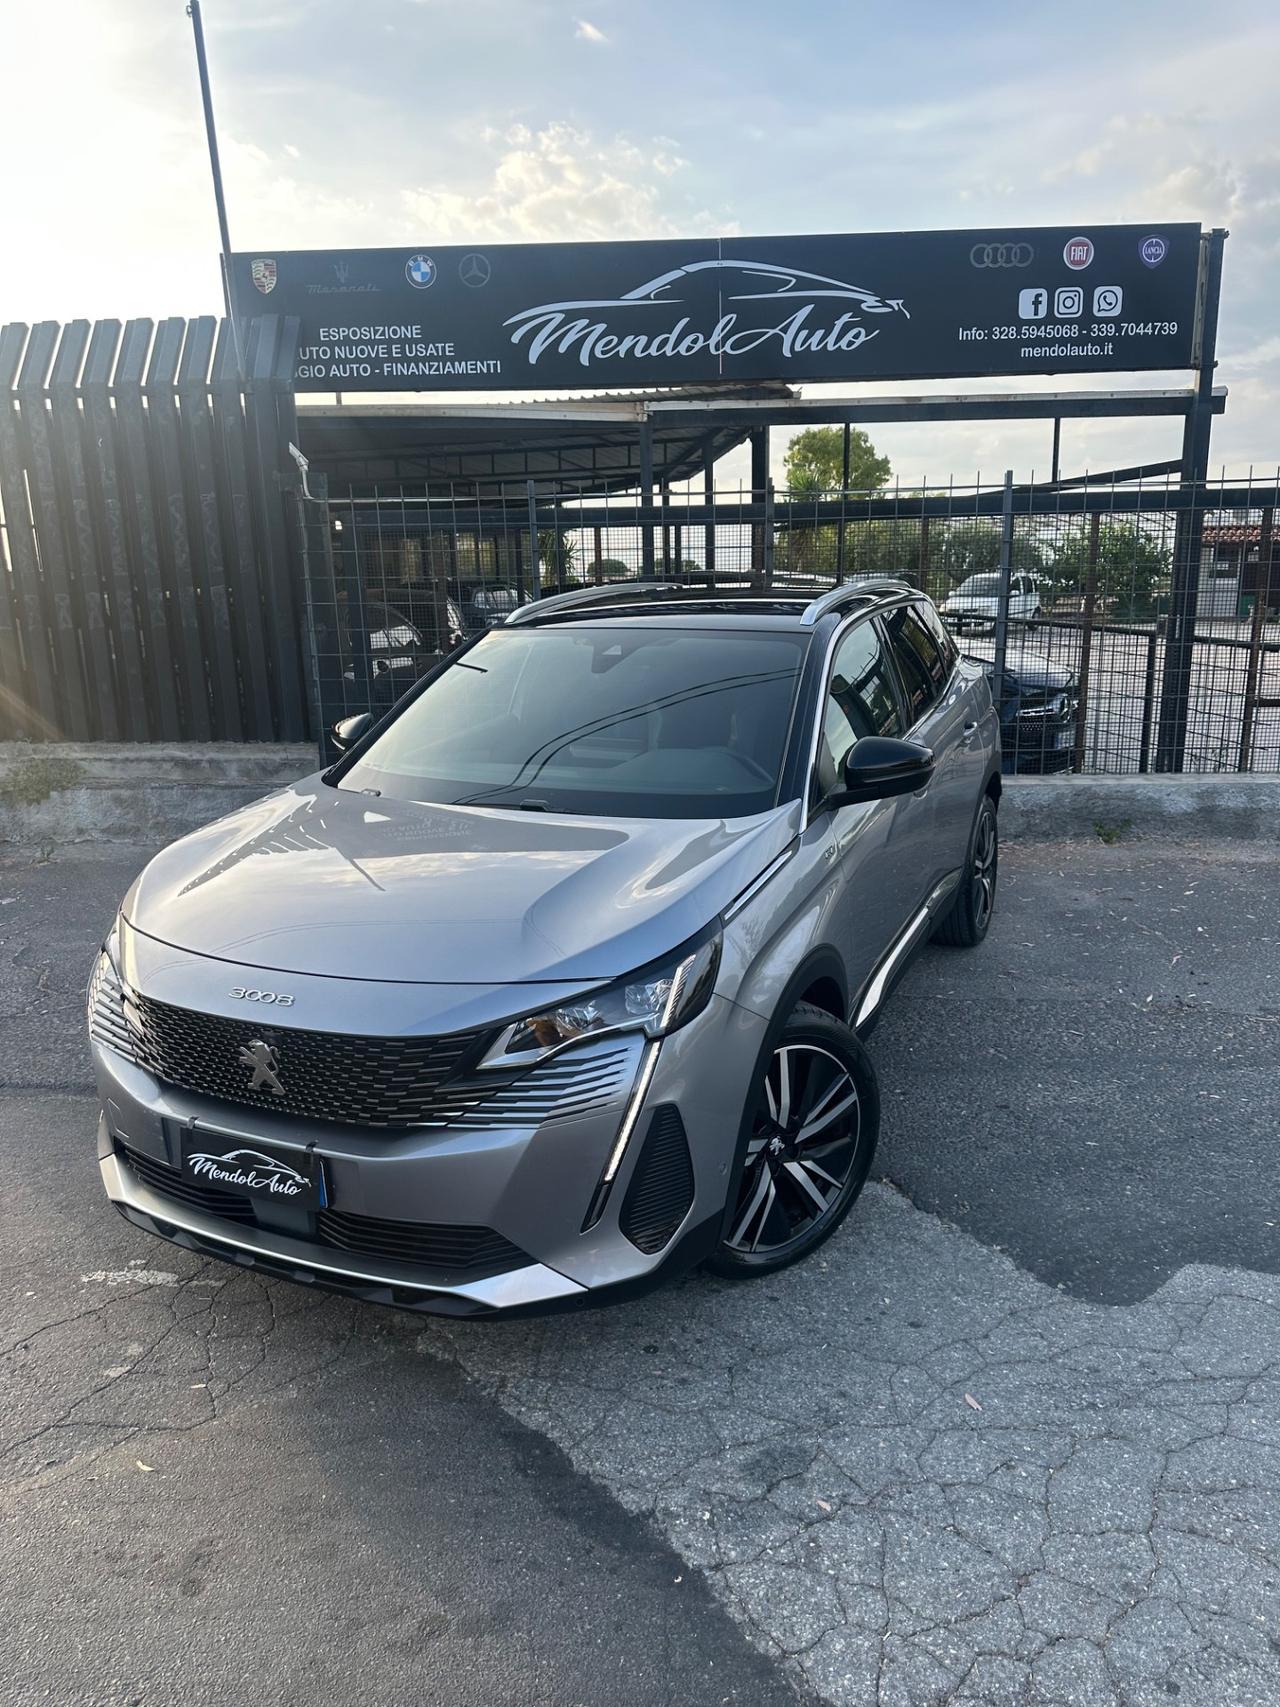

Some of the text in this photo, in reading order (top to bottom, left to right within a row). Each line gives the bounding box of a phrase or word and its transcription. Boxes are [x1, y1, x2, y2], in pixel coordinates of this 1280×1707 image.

[408, 255, 433, 267] BMW
[1070, 246, 1088, 261] FIAT
[319, 325, 422, 341] ESPOSIZIONE
[510, 303, 880, 367] MendolAuto
[958, 326, 989, 341] Info:
[991, 324, 1079, 340] 328.5945068
[1090, 321, 1178, 337] 339.7044739
[297, 342, 455, 360] UTO NUOVE E USATE
[1020, 342, 1114, 358] mendolauto.it
[295, 364, 326, 378] GIO
[329, 363, 371, 378] AUTO
[383, 359, 501, 376] FINANZIAMENTI
[228, 986, 296, 1007] 3008
[189, 1157, 302, 1196] MendolAuto
